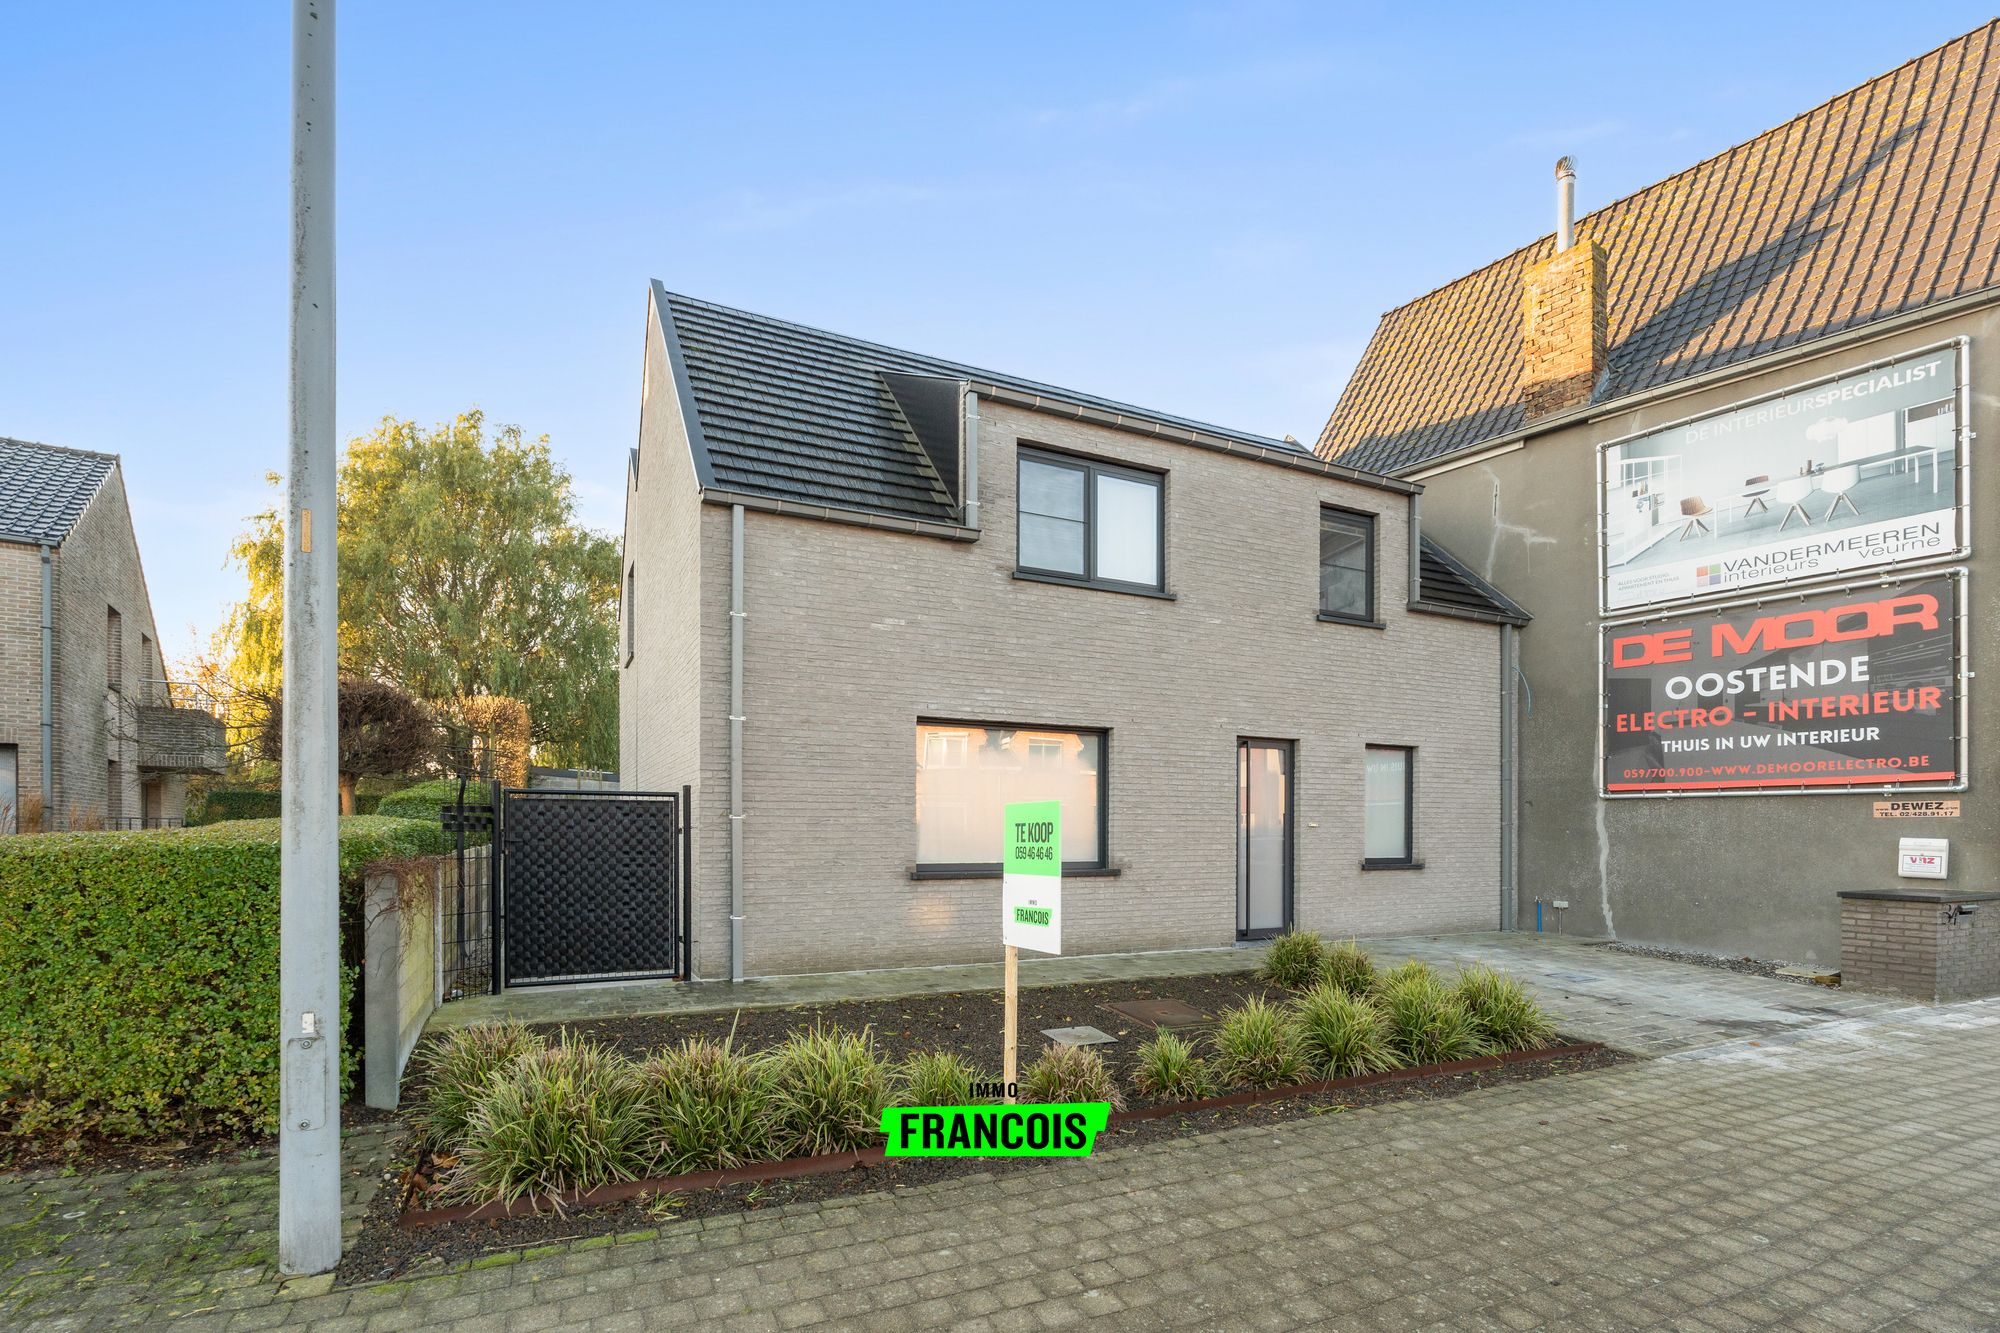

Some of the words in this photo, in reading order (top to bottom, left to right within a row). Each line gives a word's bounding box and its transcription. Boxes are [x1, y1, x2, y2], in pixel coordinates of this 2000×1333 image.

[1685, 427, 1709, 445] DE
[1714, 361, 1942, 437] INTERIEURSPECIALIST
[1723, 522, 1940, 572] VANDERMEEREN
[1724, 557, 1819, 583] interieurs
[1858, 536, 1941, 559] veurne
[1613, 628, 1693, 669] DE
[1712, 593, 1939, 657] MOOR
[1665, 656, 1870, 700] OOSTENDE
[1616, 705, 1733, 732] ELECTRO
[1768, 687, 1942, 722] INTERIEUR
[1661, 738, 1710, 753] THUIS
[1715, 736, 1734, 750] IN
[1740, 734, 1771, 749] UW
[1777, 727, 1880, 747] INTERIEUR
[1015, 823, 1026, 842] TE
[1028, 822, 1053, 843] KOOP
[1015, 846, 1026, 860] 059
[1027, 846, 1035, 860] 46
[1036, 846, 1044, 860] 46
[1045, 846, 1053, 860] 46
[1016, 908, 1049, 925] FRANCOIS
